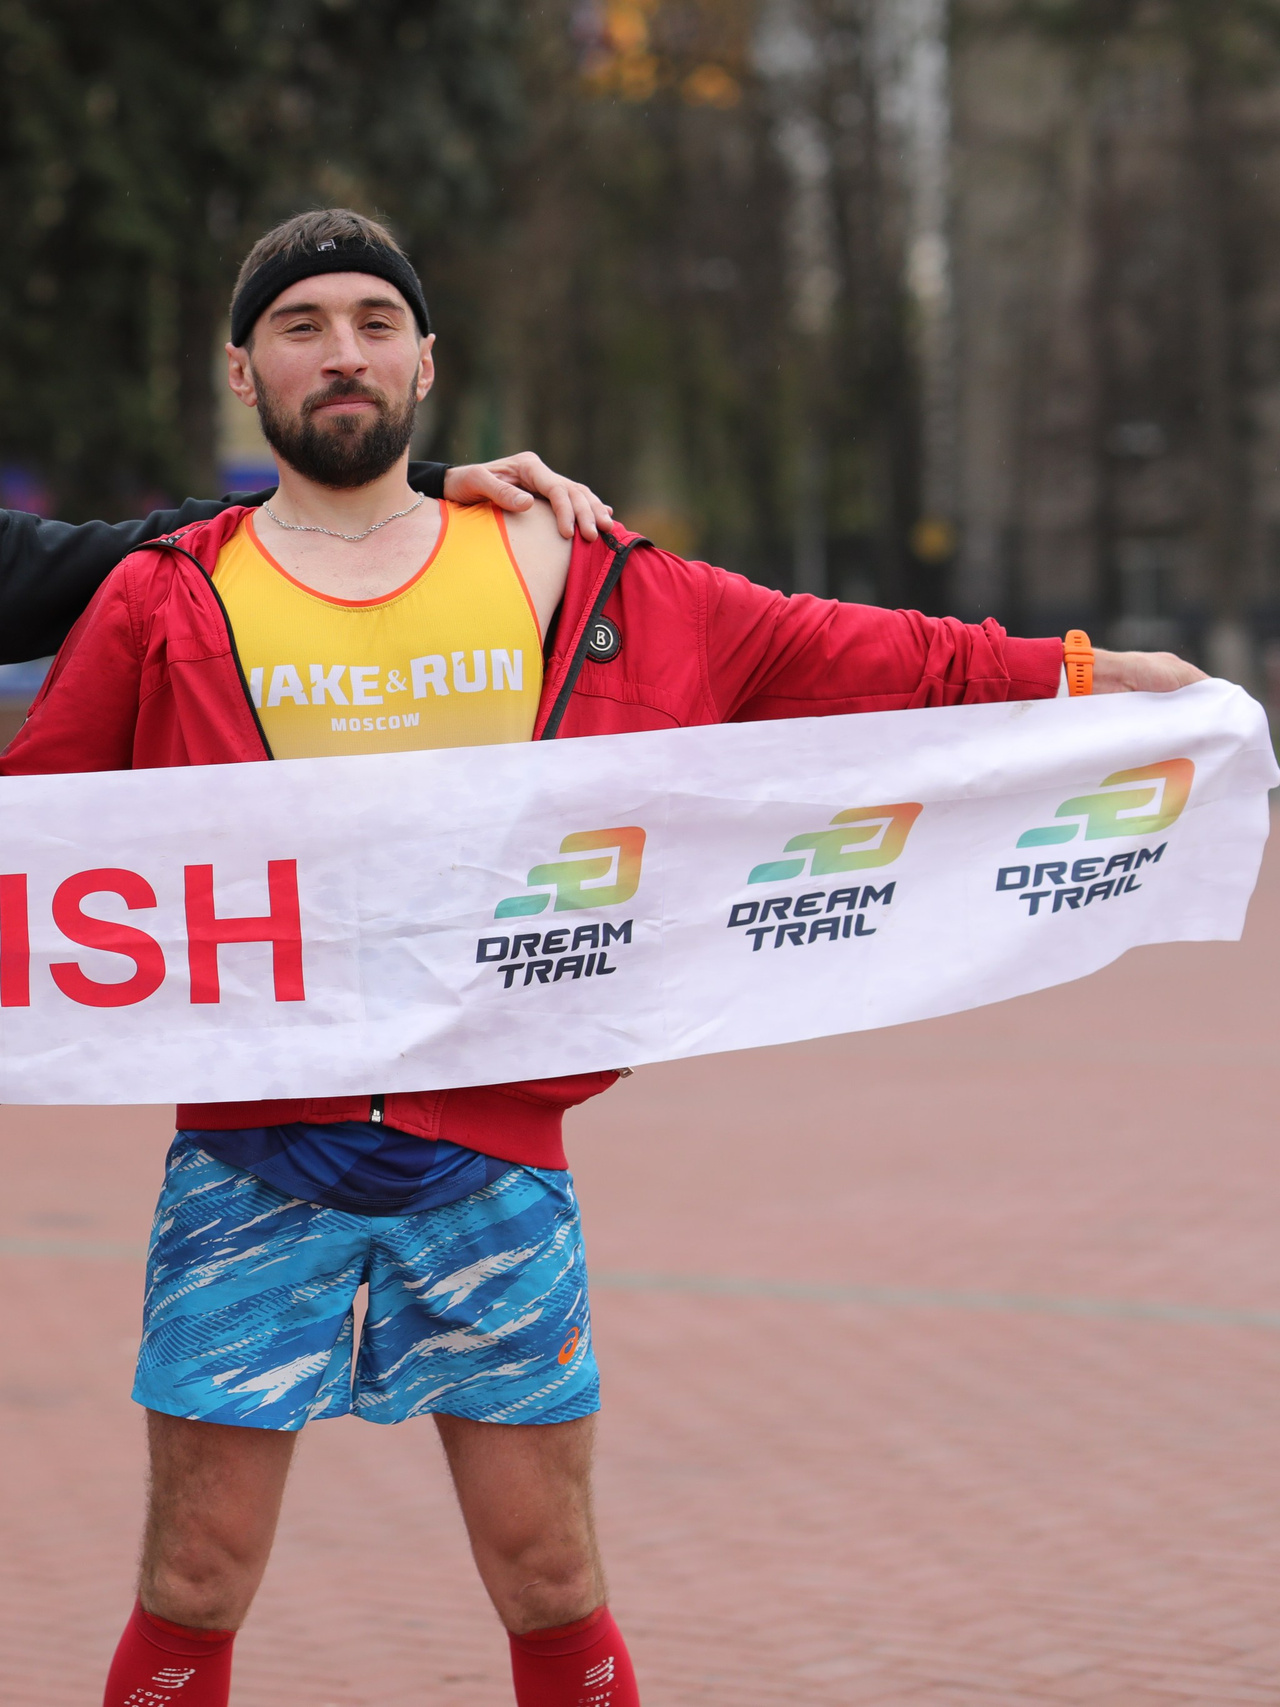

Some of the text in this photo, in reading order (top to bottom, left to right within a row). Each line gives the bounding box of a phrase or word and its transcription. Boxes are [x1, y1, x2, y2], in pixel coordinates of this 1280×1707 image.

[331, 712, 420, 732] MOSCOW
[995, 841, 1168, 892] DREAM
[726, 881, 897, 928] DREAM
[1019, 873, 1143, 916] TRAIL
[475, 919, 634, 964] DREAM
[745, 913, 877, 952] TRAIL
[497, 951, 617, 989] TRAIL
